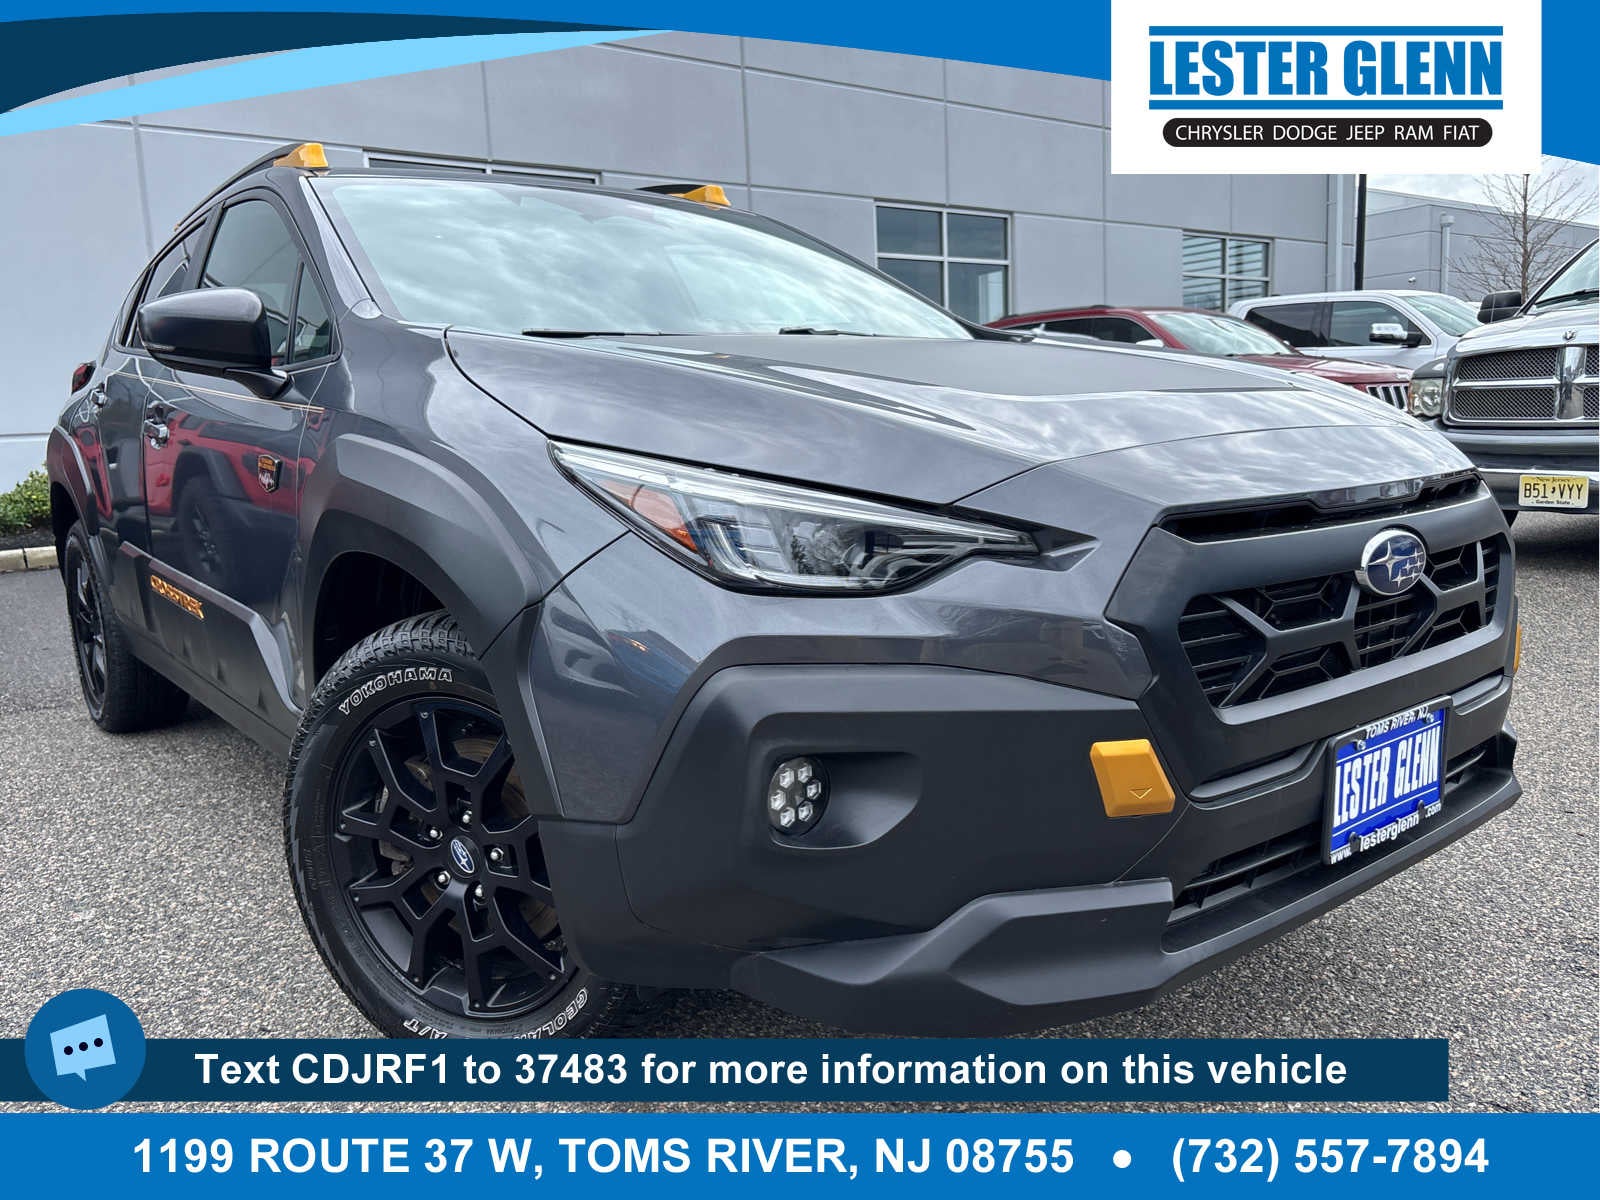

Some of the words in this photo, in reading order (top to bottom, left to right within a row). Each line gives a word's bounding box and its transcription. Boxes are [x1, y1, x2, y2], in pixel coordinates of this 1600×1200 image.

[338, 666, 453, 716] YOKOHAMA
[1365, 718, 1391, 739] TOMS
[1417, 706, 1429, 721] NJ
[1333, 746, 1391, 828] LESTER
[1394, 726, 1441, 798] GLENN
